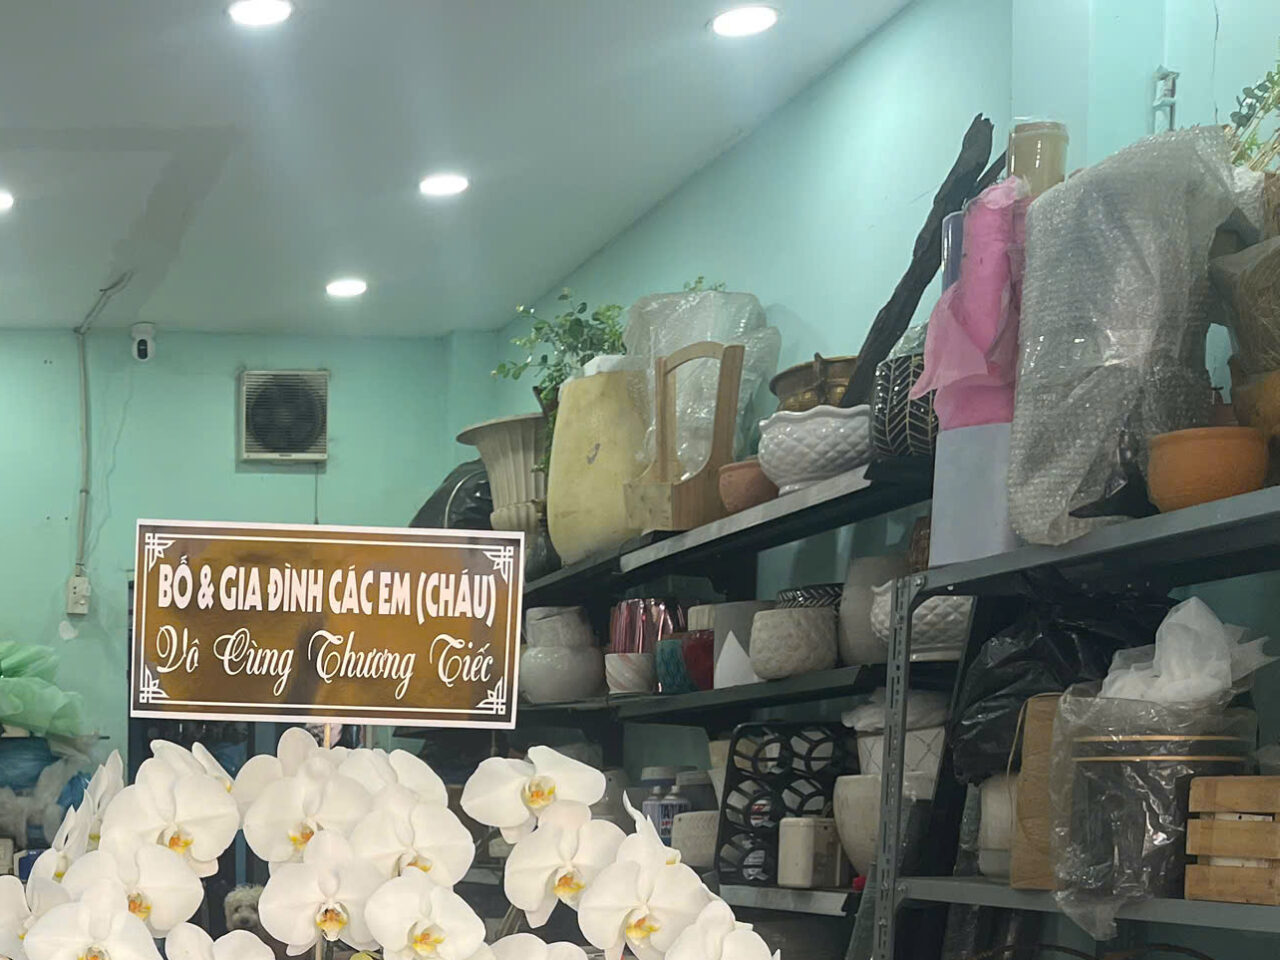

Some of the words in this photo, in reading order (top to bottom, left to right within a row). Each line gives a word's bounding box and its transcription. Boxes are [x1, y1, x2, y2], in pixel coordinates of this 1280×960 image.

[158, 555, 193, 609] BỐ
[197, 564, 214, 610] &
[220, 566, 262, 611] GIA
[267, 563, 323, 613] ĐÌNH
[329, 565, 373, 615] CÁC
[378, 572, 411, 616] EM
[416, 569, 496, 627] (CHÁU)
[156, 625, 200, 674] Vô
[213, 628, 294, 697] Cùng
[308, 630, 416, 700] Thương
[429, 633, 494, 688] Tiếc
